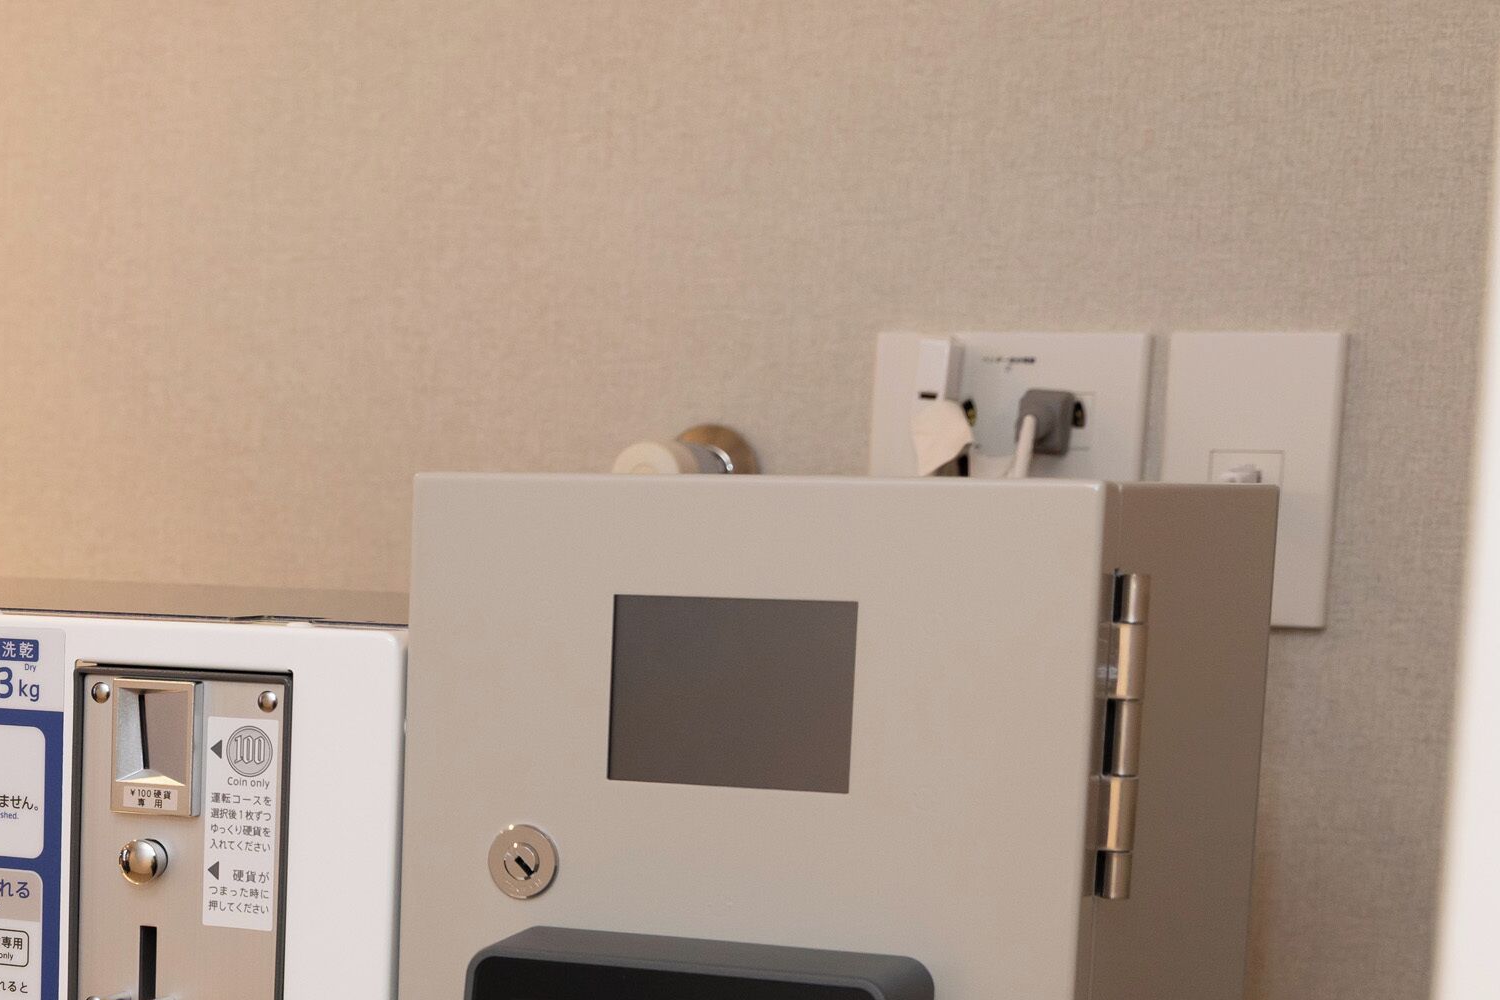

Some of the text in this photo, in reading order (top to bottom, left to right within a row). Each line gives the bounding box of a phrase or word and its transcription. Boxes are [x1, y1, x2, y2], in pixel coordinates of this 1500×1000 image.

[2, 640, 35, 659] 洗乾
[24, 663, 36, 673] Dry
[227, 776, 270, 789] Coin only
[211, 792, 271, 807] 運転コースを
[210, 824, 271, 838] ゆっくり硬貨を
[210, 838, 270, 853] 入れてください
[233, 869, 269, 884] 硬貨が
[209, 885, 269, 900] つまった時に
[208, 900, 269, 915] 押してください
